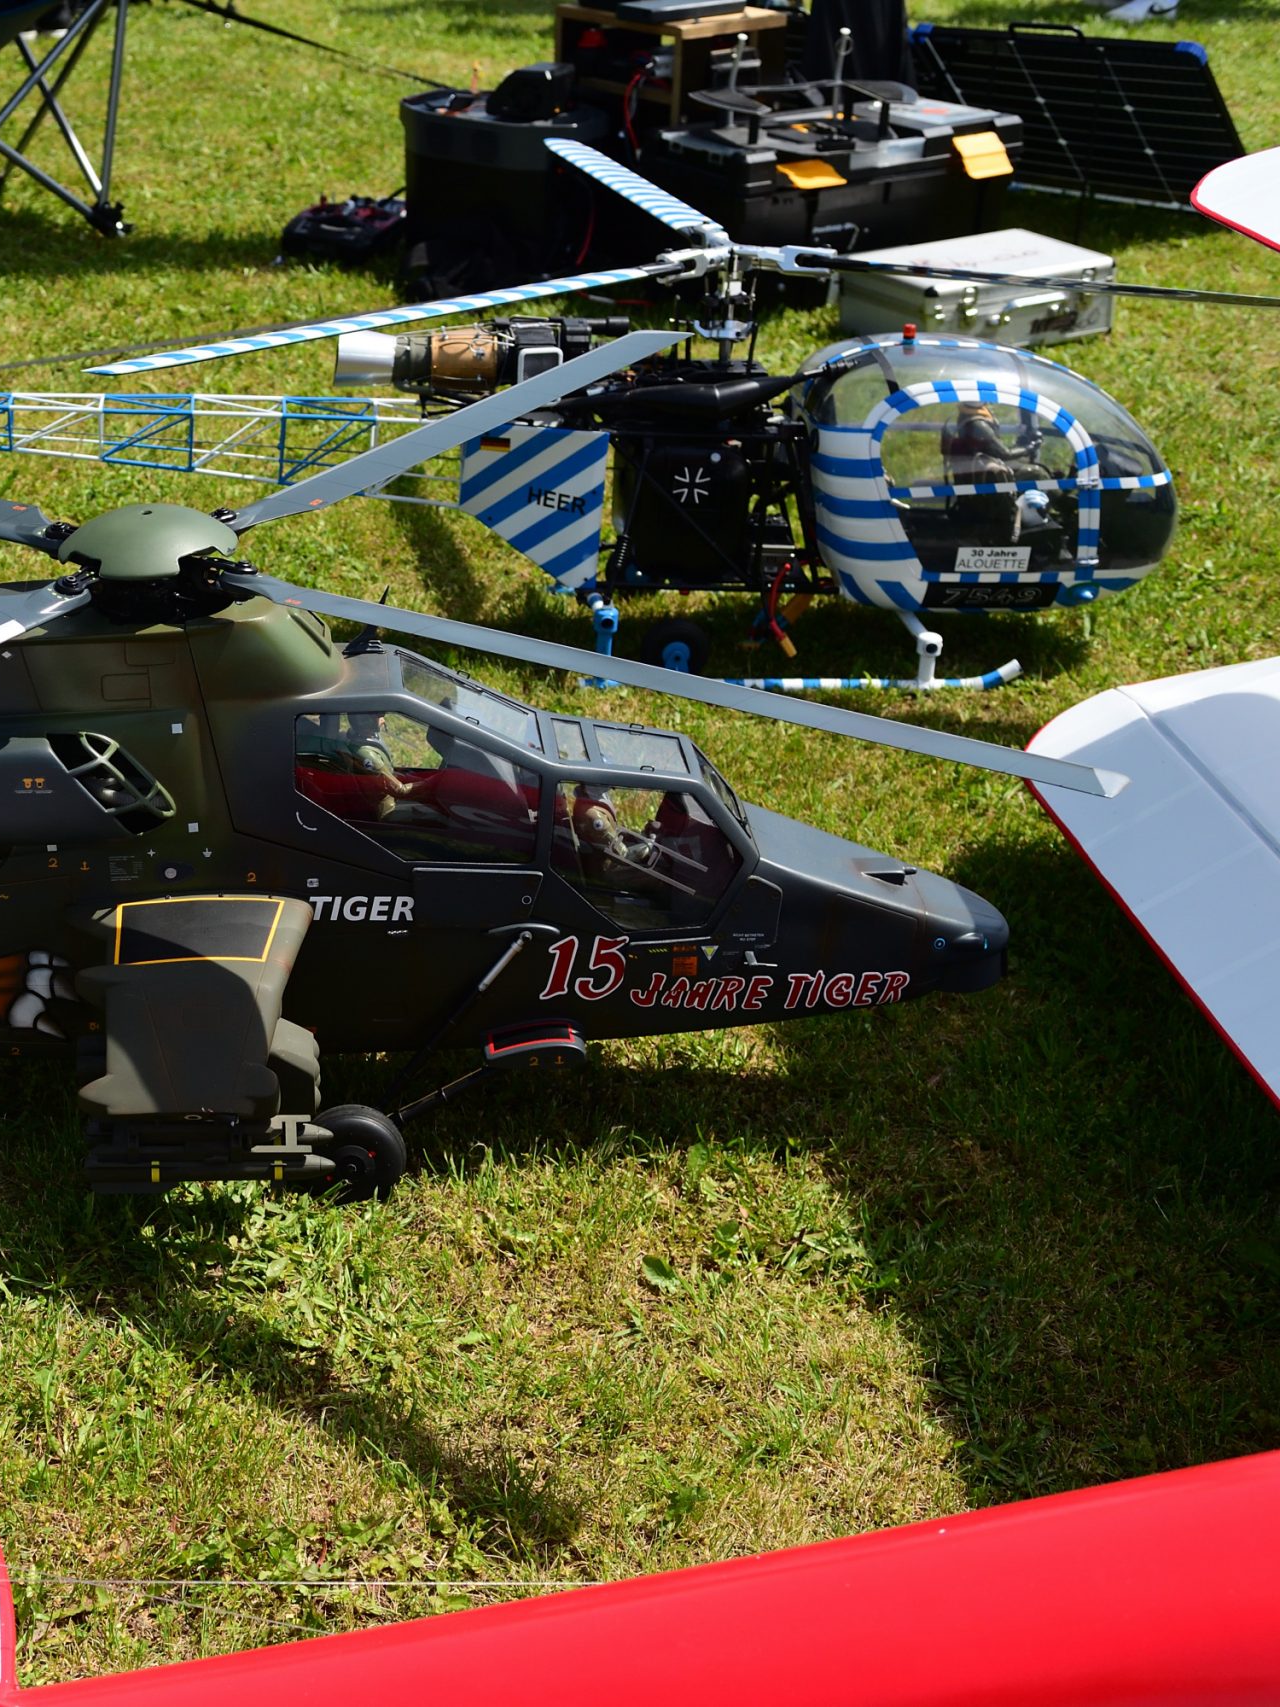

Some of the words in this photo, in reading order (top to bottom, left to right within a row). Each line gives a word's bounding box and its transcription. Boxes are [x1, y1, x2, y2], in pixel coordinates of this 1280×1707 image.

[527, 486, 586, 516] HEER
[957, 558, 1027, 569] ALOUETTE
[971, 549, 984, 557] 30
[987, 549, 1018, 557] Jahre
[309, 896, 415, 921] TIGER
[539, 936, 630, 1001] 15
[630, 972, 773, 1012] JAHRE
[784, 970, 910, 1010] TIGER
